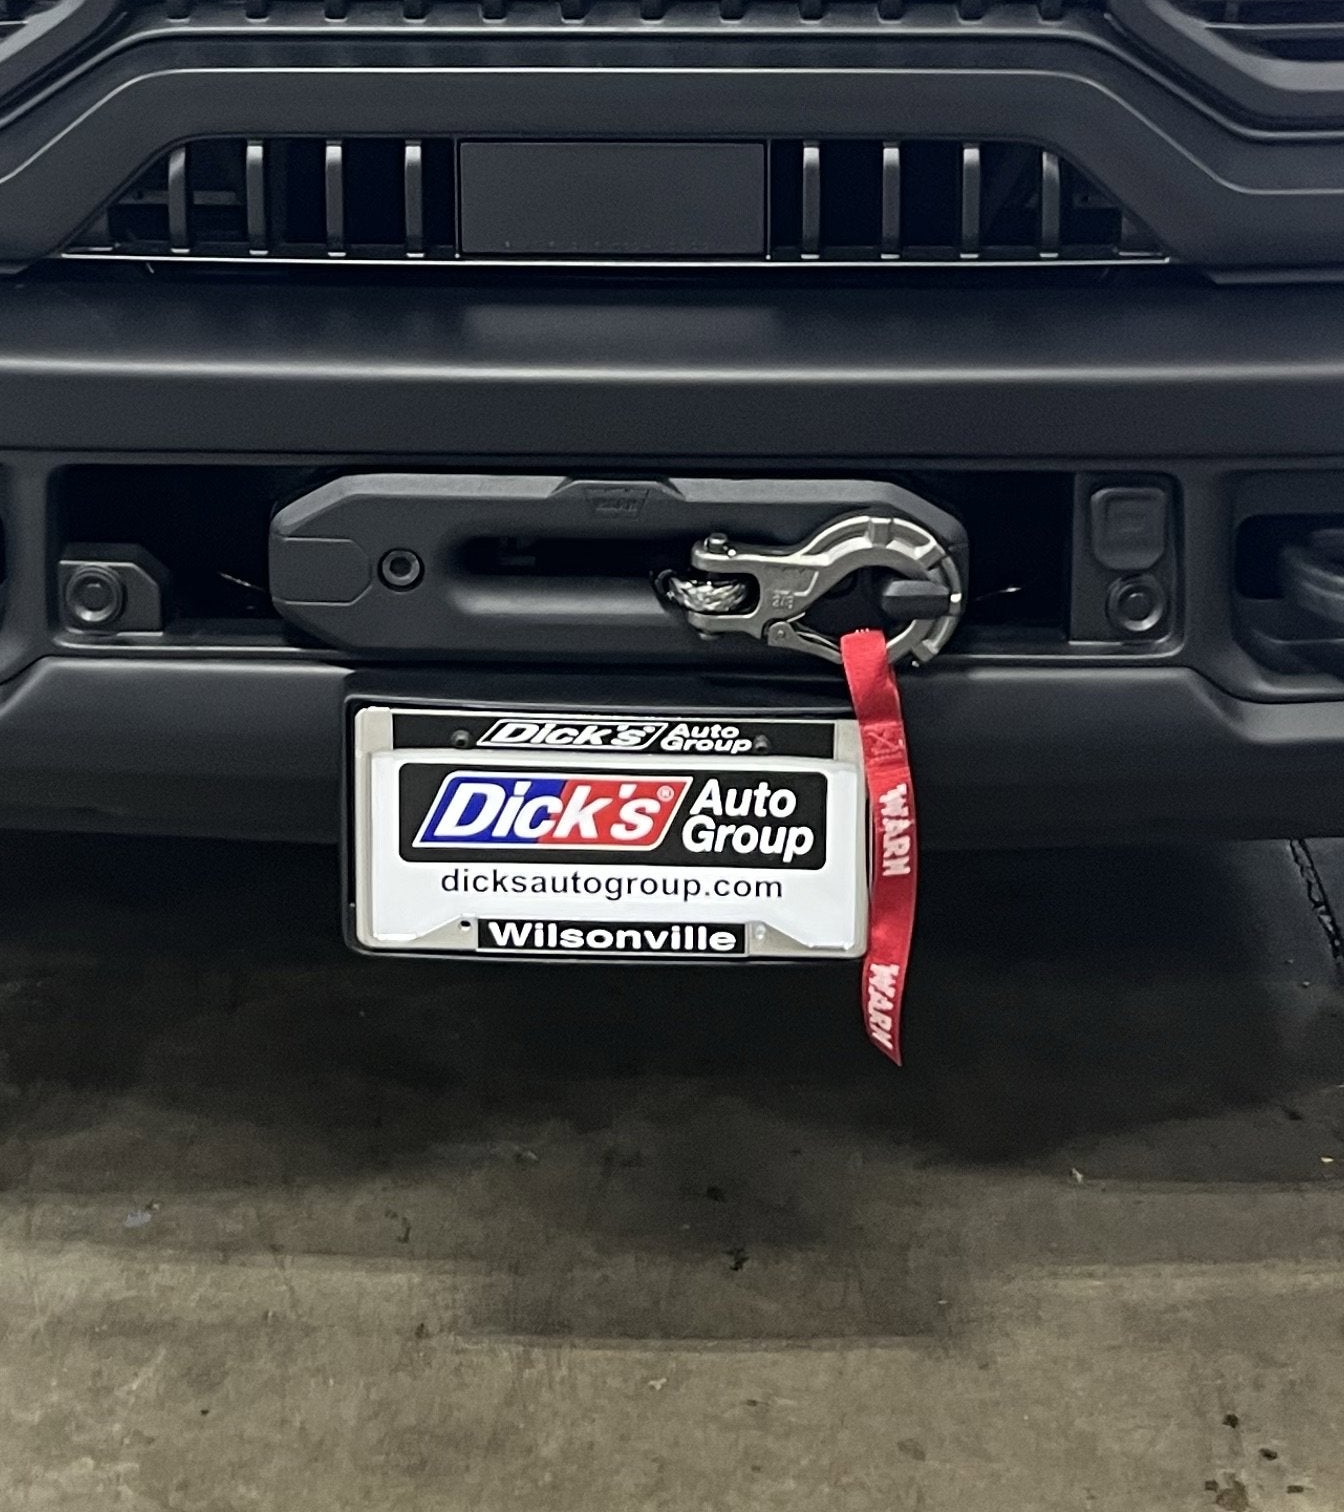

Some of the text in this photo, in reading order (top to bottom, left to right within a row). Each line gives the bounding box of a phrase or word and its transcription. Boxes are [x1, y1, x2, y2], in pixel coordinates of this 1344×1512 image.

[490, 722, 740, 747] Dick's Auto
[660, 736, 753, 754] Group
[433, 778, 797, 842] Dick's Auto
[879, 783, 913, 876] WARN
[681, 814, 815, 863] Group
[441, 868, 783, 902] dicksautogroup.com
[487, 921, 737, 951] Wilsonville
[868, 963, 900, 1050] WARN
